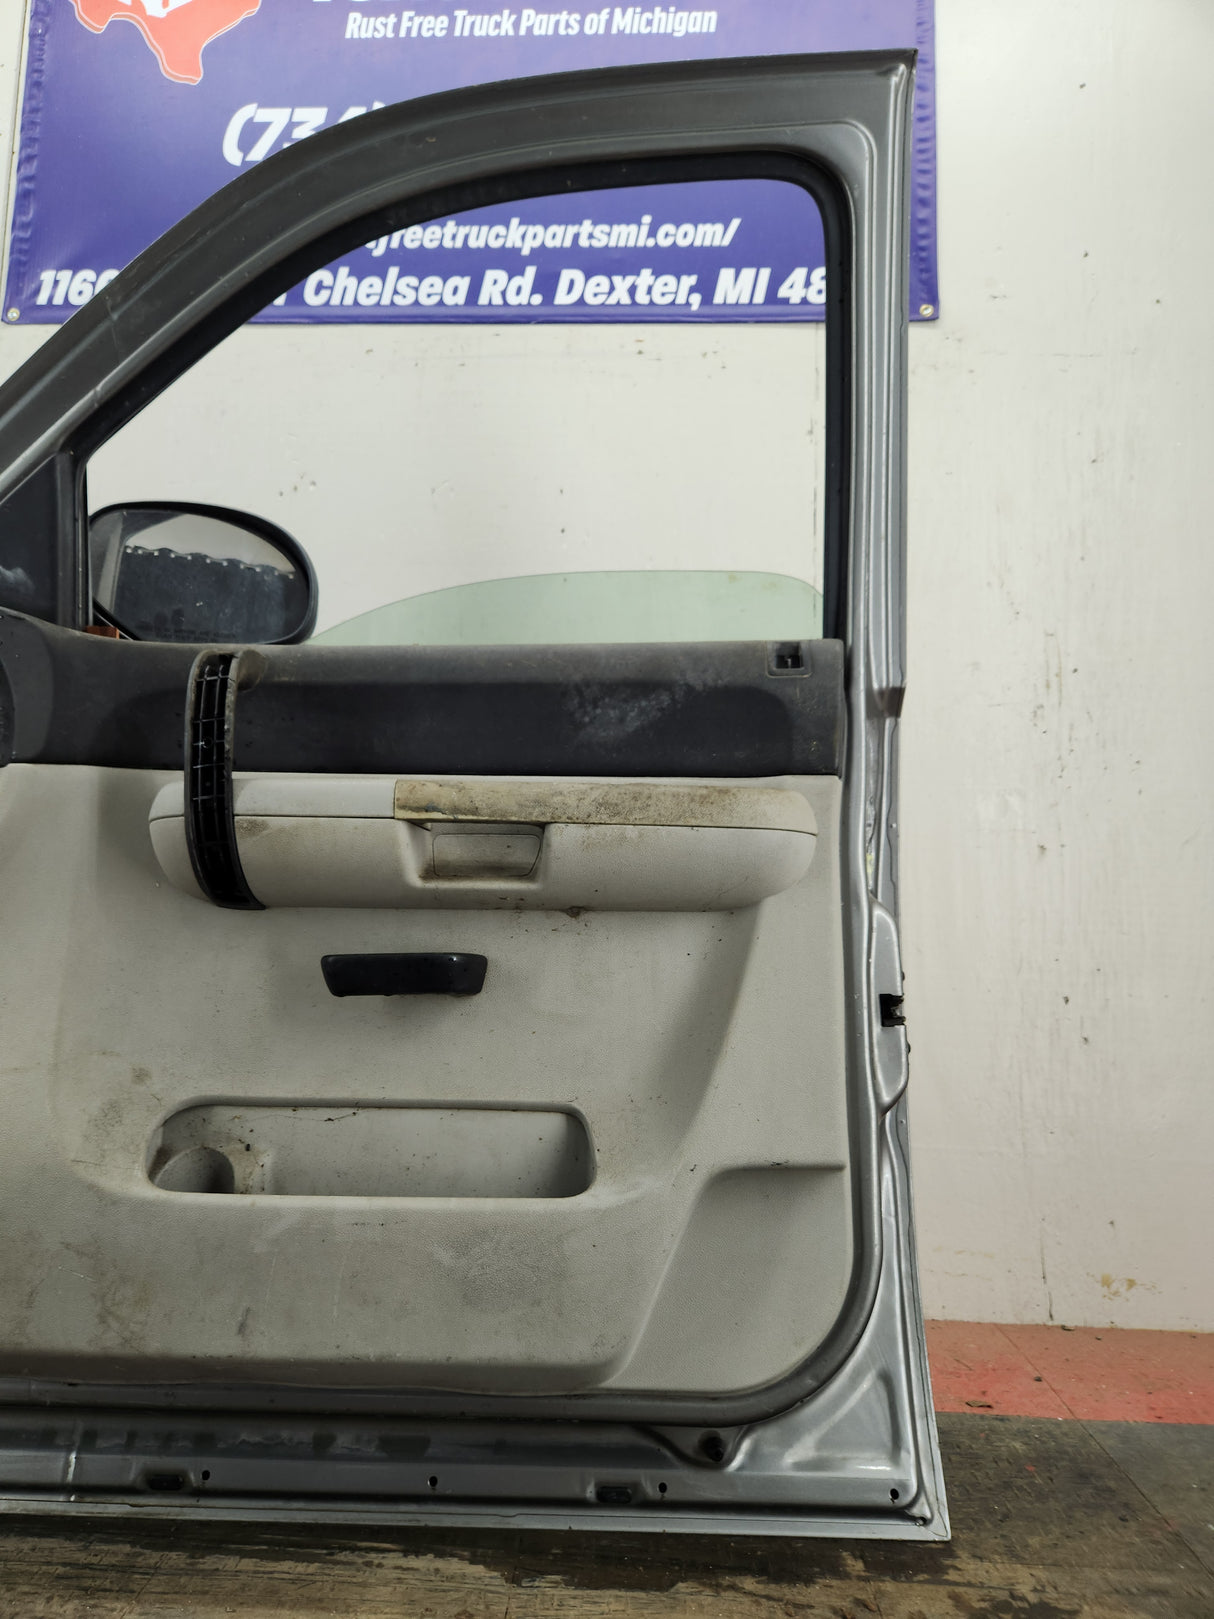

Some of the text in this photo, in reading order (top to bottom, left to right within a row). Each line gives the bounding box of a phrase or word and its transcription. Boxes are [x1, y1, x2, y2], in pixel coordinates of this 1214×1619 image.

[344, 6, 719, 39] Rust Free Truck Parts of Michigan
[222, 100, 386, 167] (73
[303, 266, 471, 307] Chelsea
[477, 269, 543, 305] Rd.
[553, 268, 702, 311] Dexter,
[712, 268, 771, 304] MI
